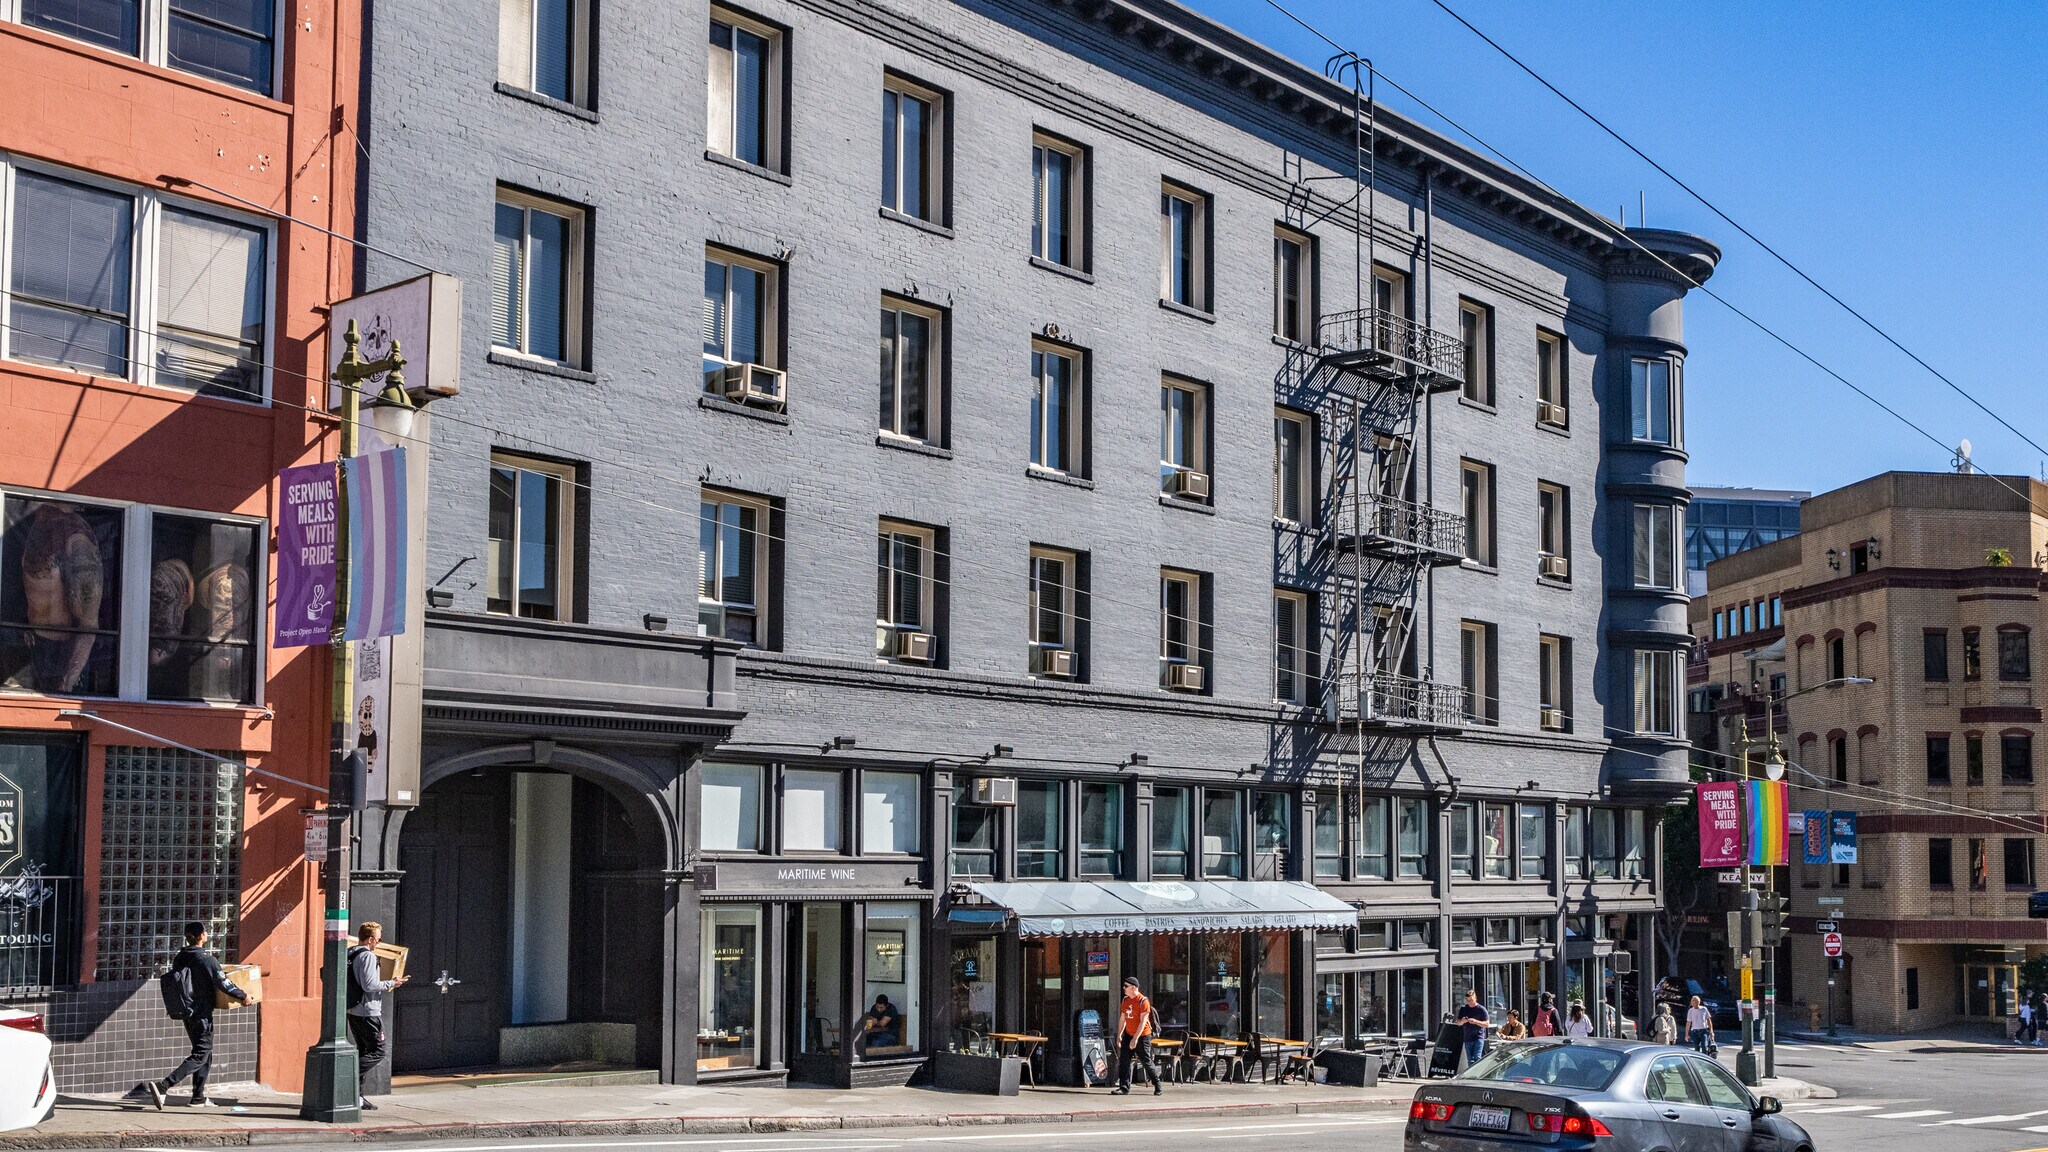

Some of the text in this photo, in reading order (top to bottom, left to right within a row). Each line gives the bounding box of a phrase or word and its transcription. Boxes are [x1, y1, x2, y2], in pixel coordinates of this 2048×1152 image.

[288, 480, 333, 504] SERVING
[298, 502, 334, 524] MEALS
[306, 524, 334, 545] WITH
[302, 545, 334, 566] PRIDE
[280, 625, 327, 638] Project Open Hand
[1703, 790, 1734, 800] SERVING
[1710, 800, 1736, 810] MEALS
[1716, 810, 1736, 819] WITH
[1714, 820, 1737, 829] PRIDE
[778, 869, 855, 880] MARITIME WINE
[1104, 918, 1130, 928] COFFEE
[1146, 916, 1175, 927] PASTRIES
[1189, 916, 1228, 926] SANDWICHES
[1240, 916, 1263, 924] SALADS
[1274, 915, 1296, 923] GELATO
[1430, 1066, 1455, 1074] RÉVEILLE
